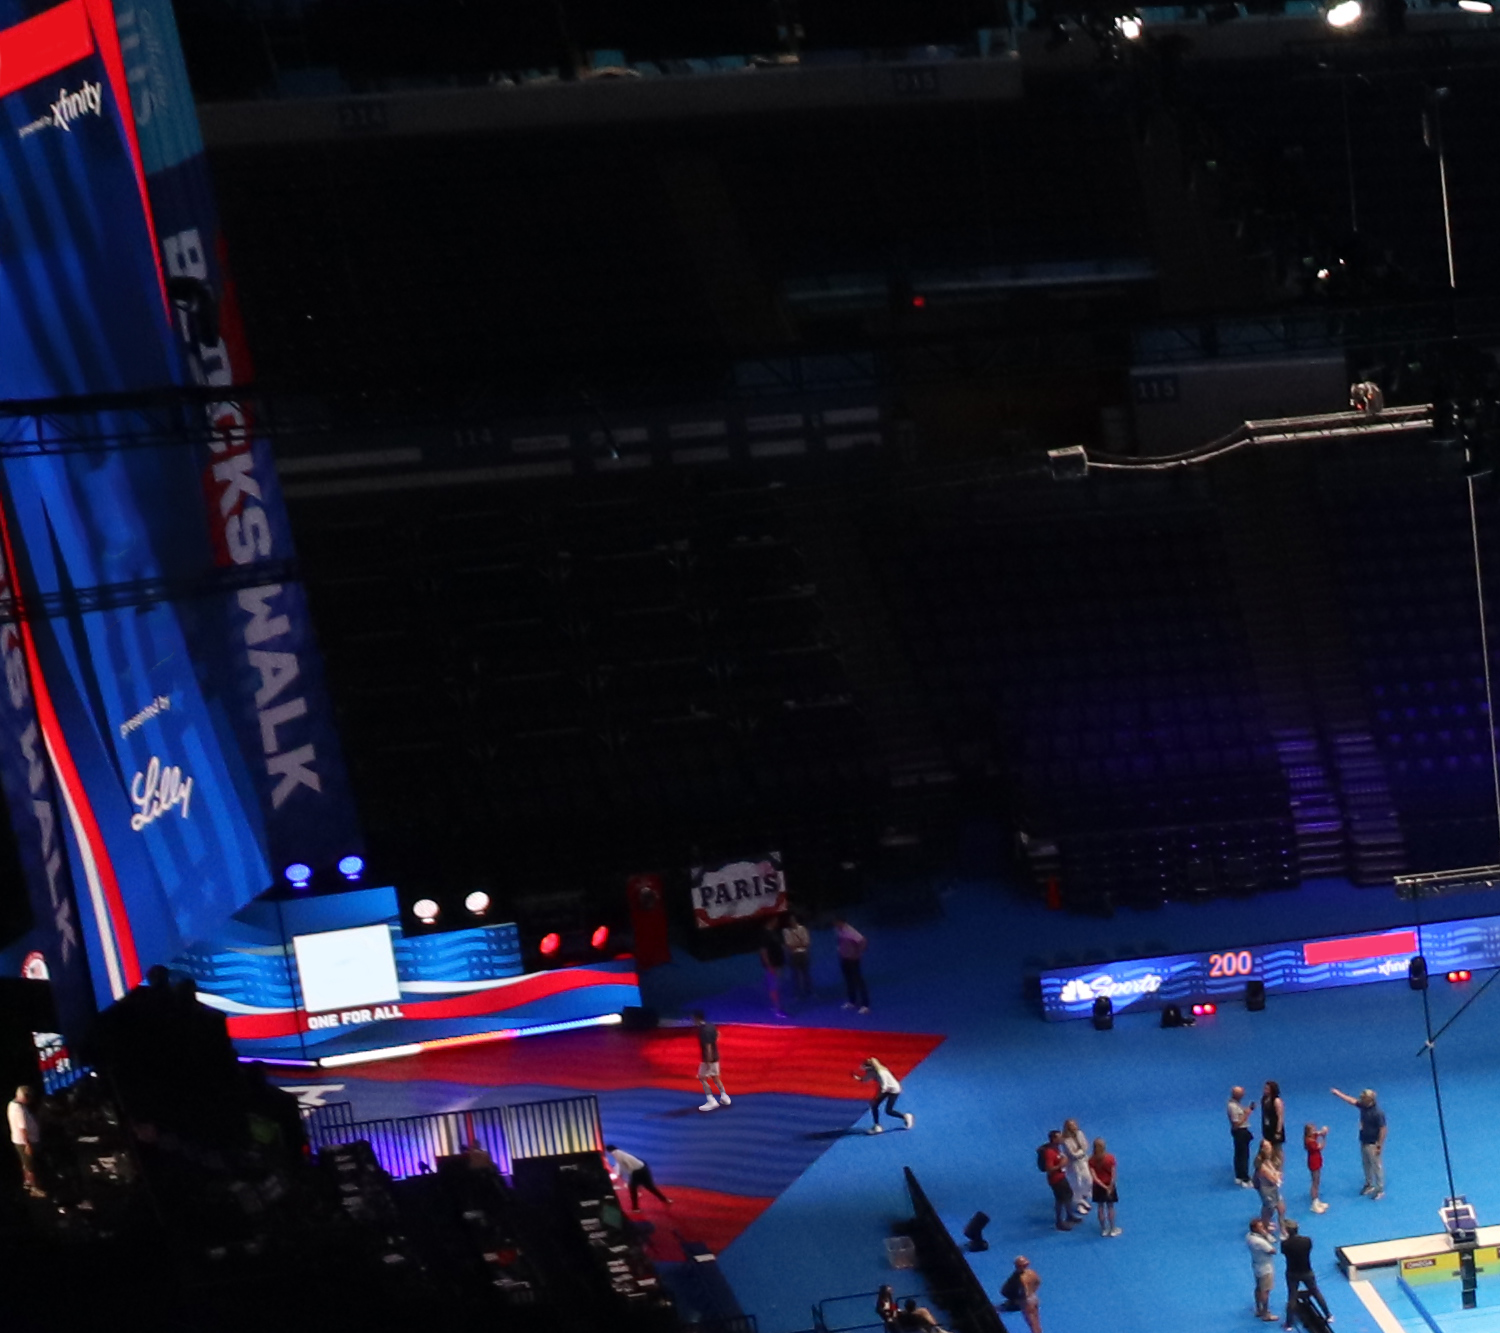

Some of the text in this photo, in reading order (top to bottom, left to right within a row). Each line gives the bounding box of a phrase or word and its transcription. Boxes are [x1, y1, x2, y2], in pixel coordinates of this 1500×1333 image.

[51, 80, 102, 132] xfinity
[453, 428, 493, 447] 114
[237, 583, 322, 811] WALK
[130, 756, 194, 833] Lilly
[701, 876, 778, 903] PARIS
[1208, 950, 1253, 978] 200
[1378, 958, 1411, 977] xfini
[1089, 973, 1163, 1000] Sports
[308, 1004, 404, 1031] ONE FOR ALL
